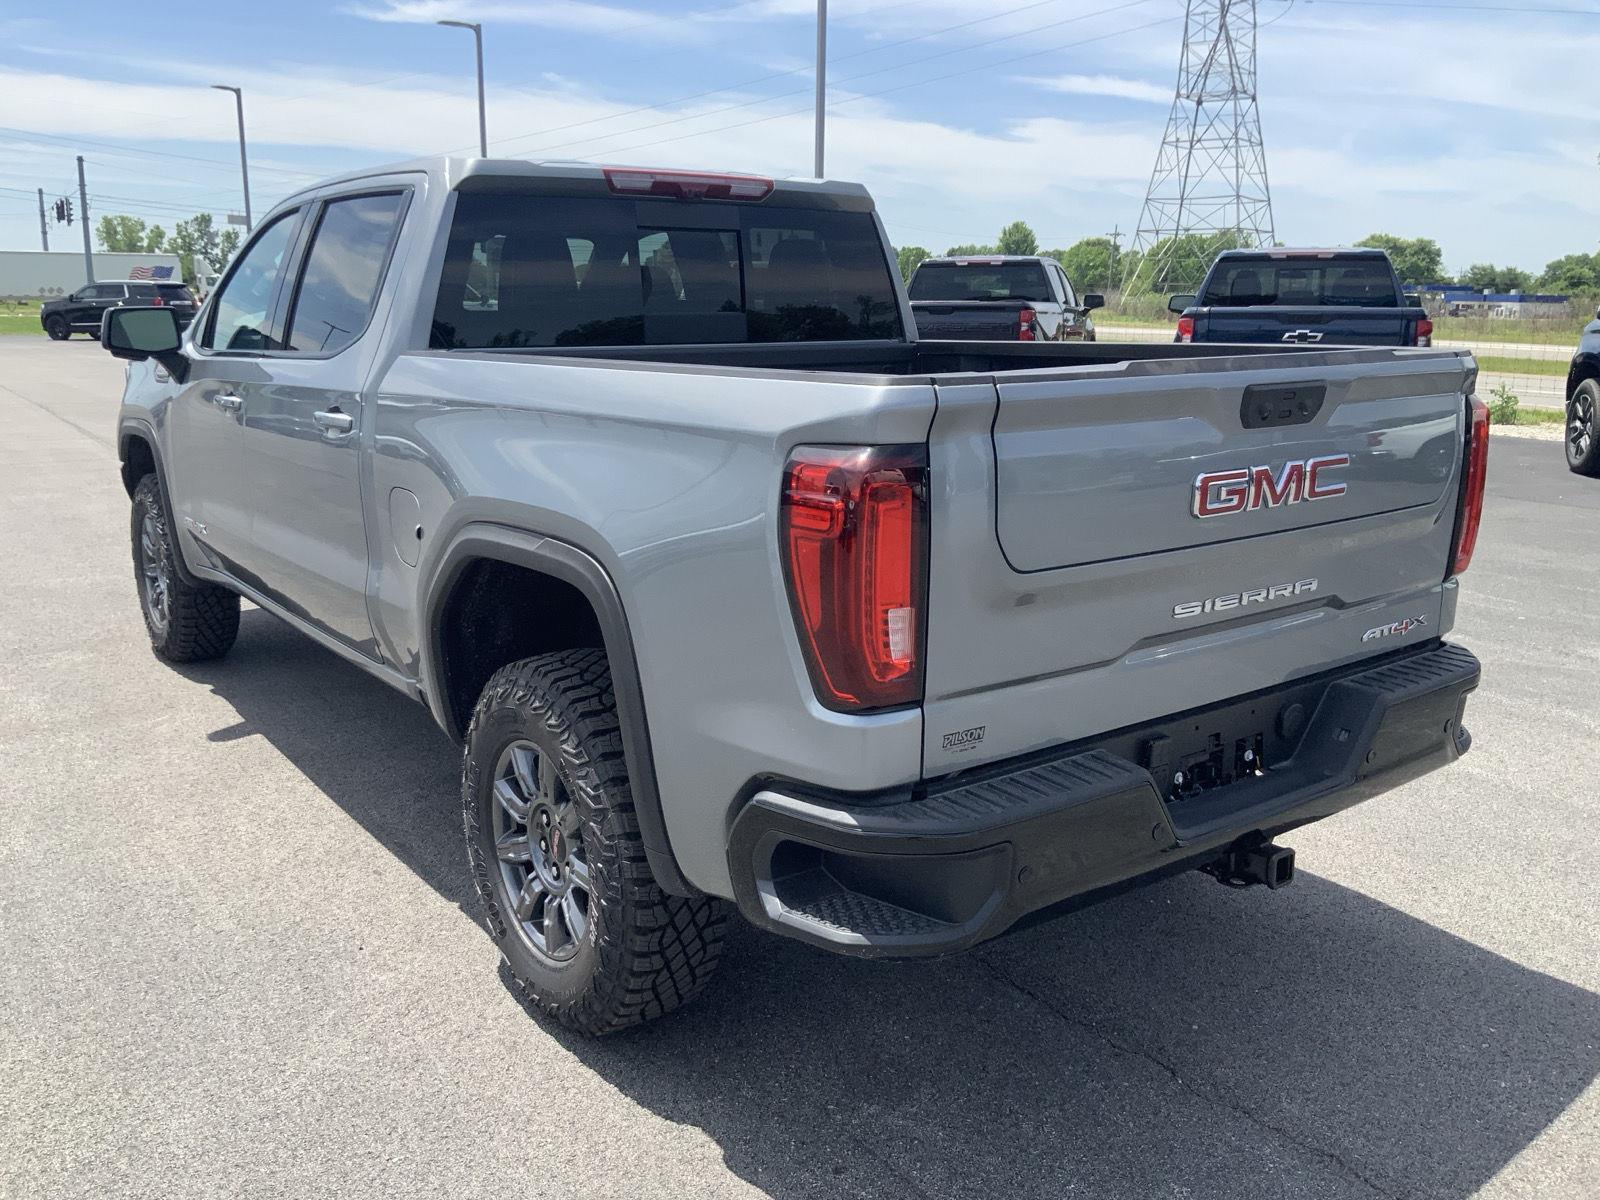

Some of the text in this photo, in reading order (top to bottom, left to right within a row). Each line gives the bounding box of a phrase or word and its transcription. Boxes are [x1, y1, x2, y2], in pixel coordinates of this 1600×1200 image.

[1192, 453, 1349, 518] GMC
[1172, 578, 1318, 618] SIERRA
[1361, 614, 1427, 642] AT4X
[942, 726, 985, 748] PILSON
